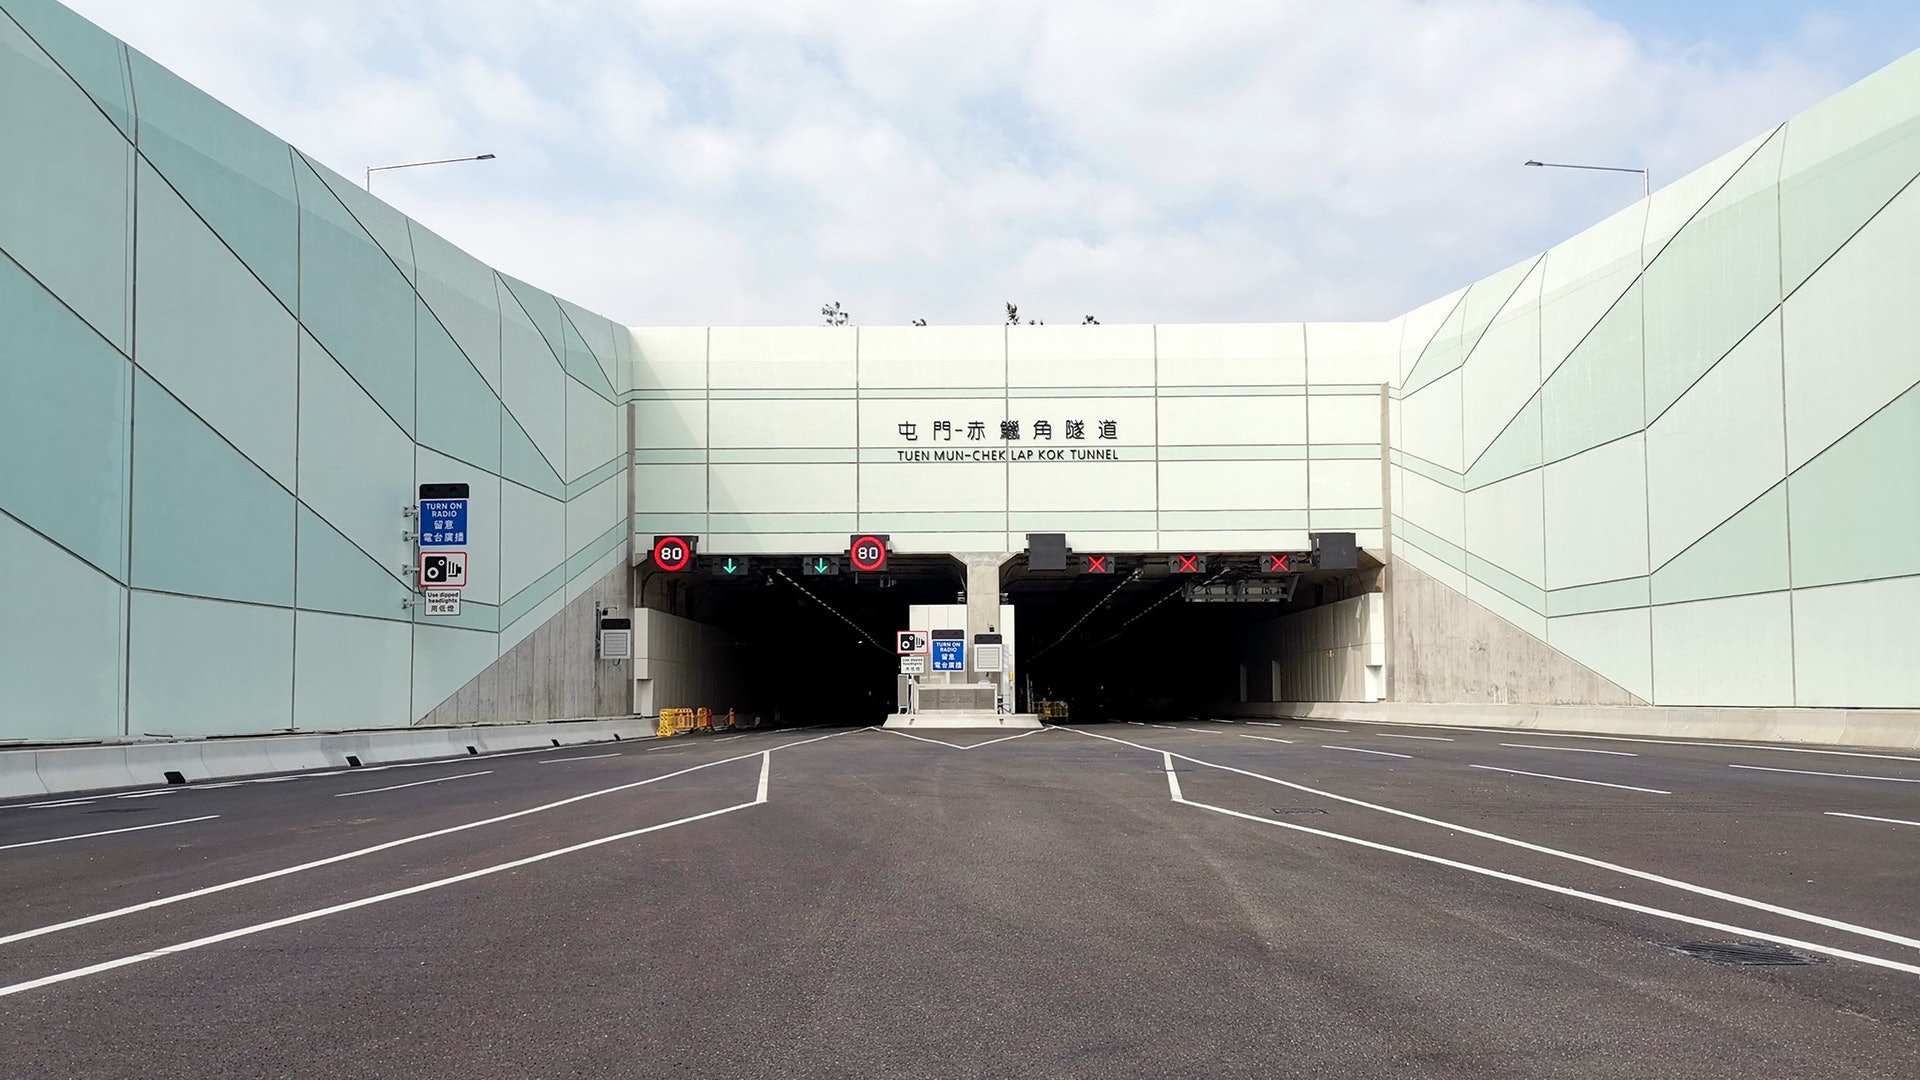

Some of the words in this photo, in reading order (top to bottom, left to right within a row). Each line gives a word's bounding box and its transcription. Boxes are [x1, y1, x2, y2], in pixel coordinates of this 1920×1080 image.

[898, 450, 930, 461] TUEN
[934, 450, 1006, 461] MUN-CHEK
[1010, 450, 1033, 461] LAP
[1038, 449, 1065, 461] KOK
[1070, 449, 1119, 461] TUNNEL
[449, 502, 463, 510] ON
[433, 520, 454, 530] 留意
[660, 547, 683, 560] 80
[858, 547, 879, 560] 80
